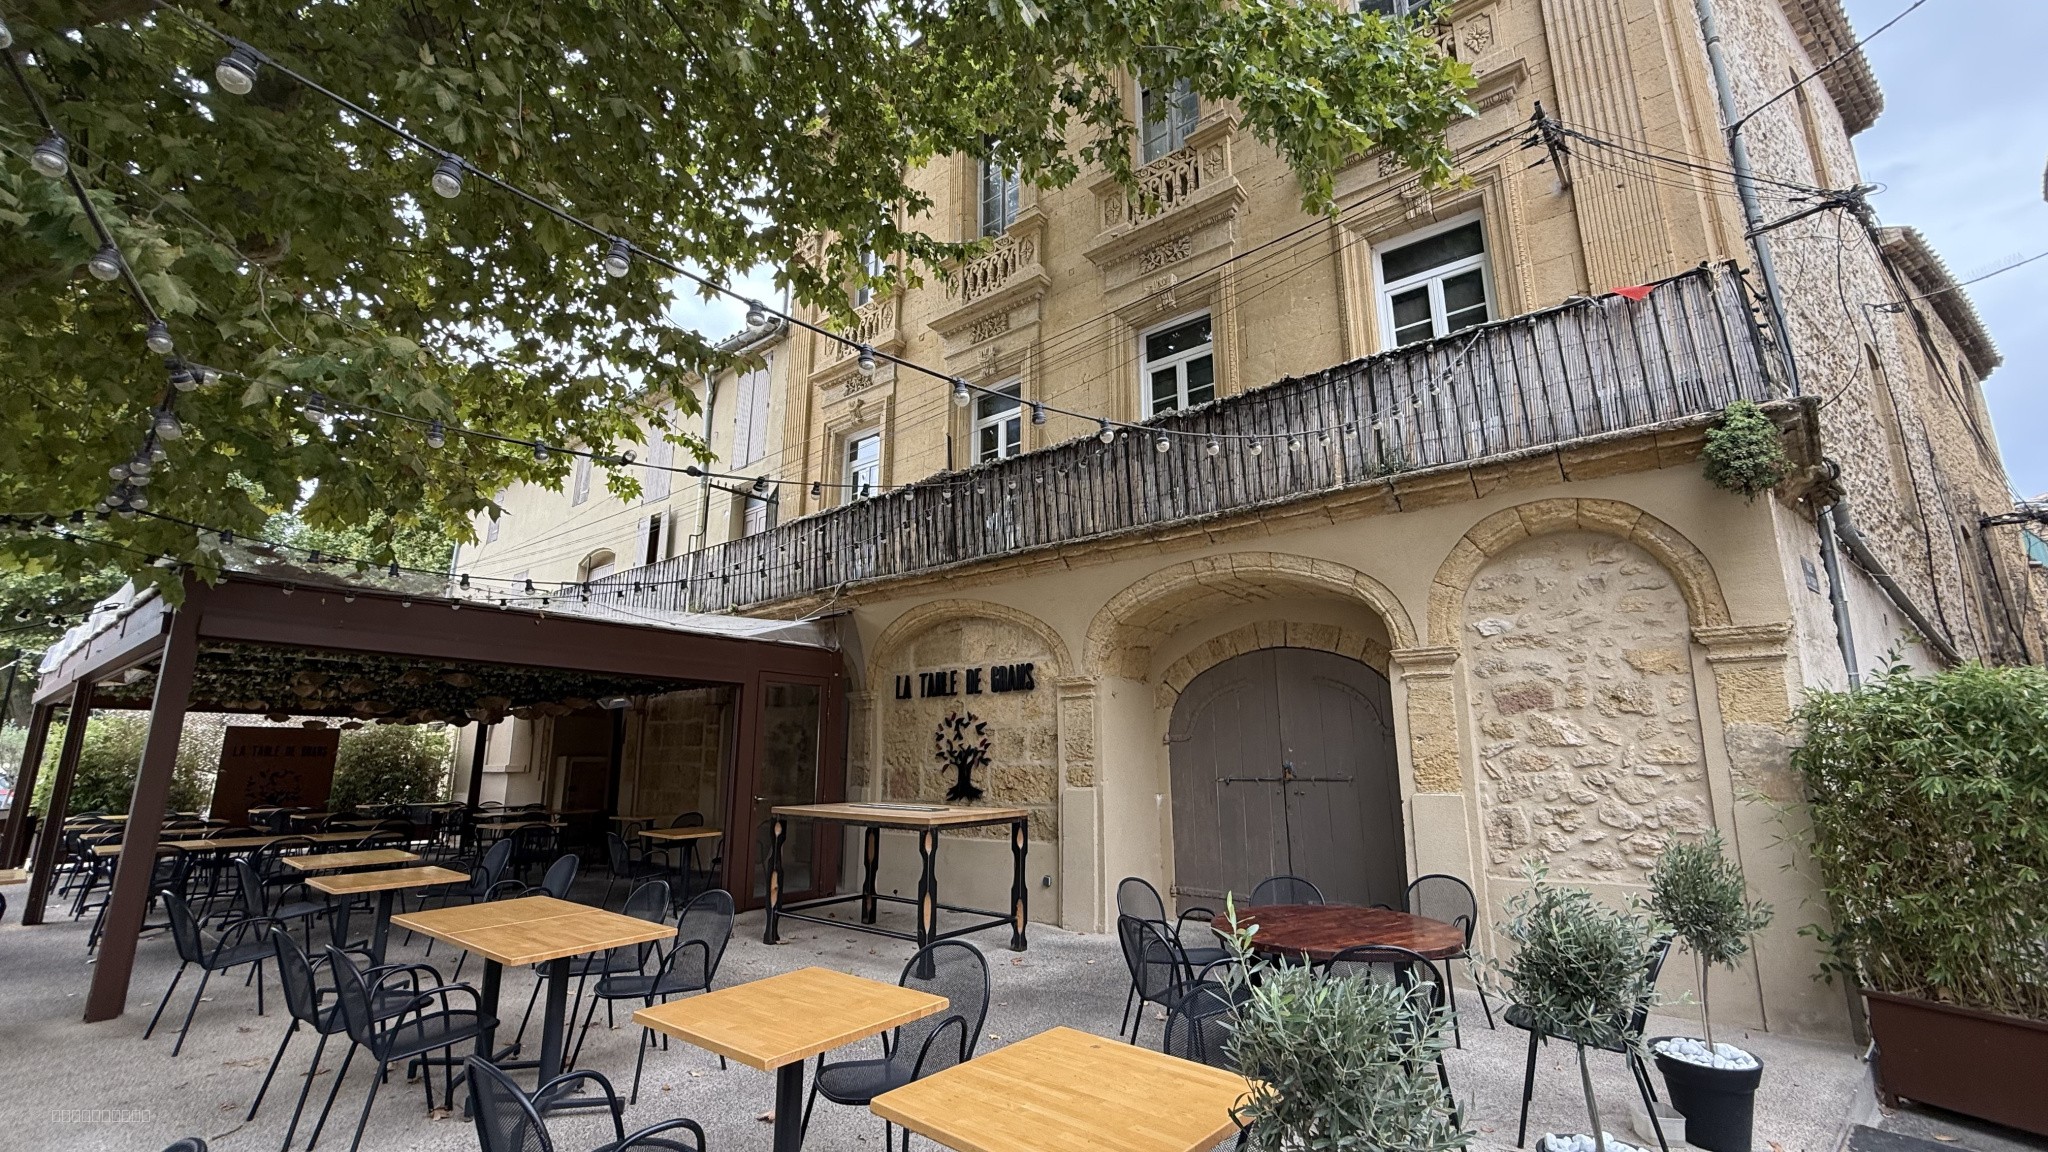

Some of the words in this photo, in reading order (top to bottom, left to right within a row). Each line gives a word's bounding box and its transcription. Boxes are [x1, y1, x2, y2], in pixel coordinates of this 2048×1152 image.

[895, 675, 912, 699] LA
[919, 670, 958, 698] TABLE
[966, 668, 983, 695] DE
[232, 745, 246, 757] LA
